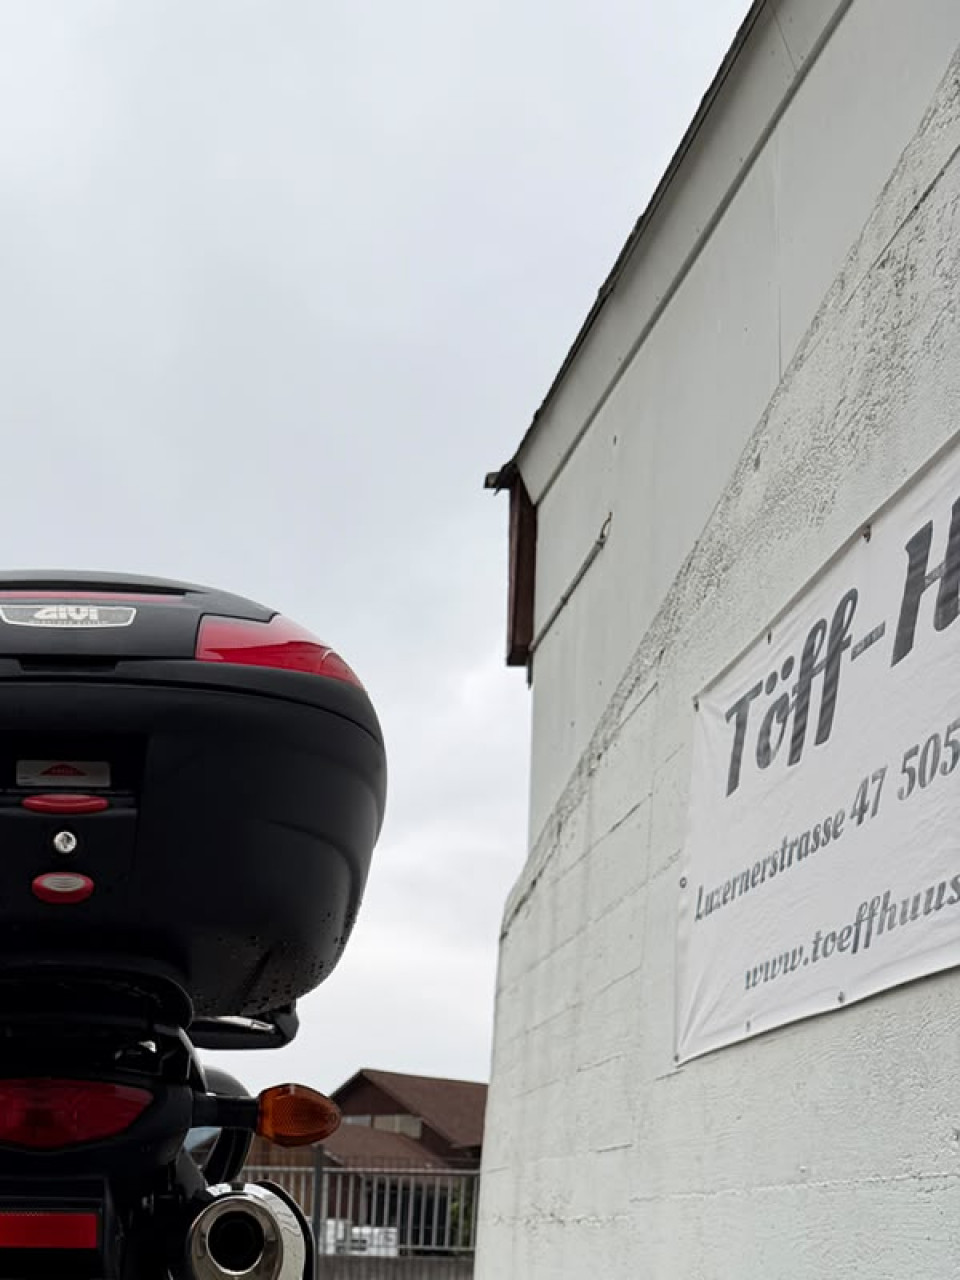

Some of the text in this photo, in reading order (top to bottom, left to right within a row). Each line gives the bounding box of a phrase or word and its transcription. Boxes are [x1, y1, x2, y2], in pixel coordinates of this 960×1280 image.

[33, 606, 98, 620] GIVI
[695, 808, 845, 922] Luzernerstrasse
[850, 765, 887, 827] 47
